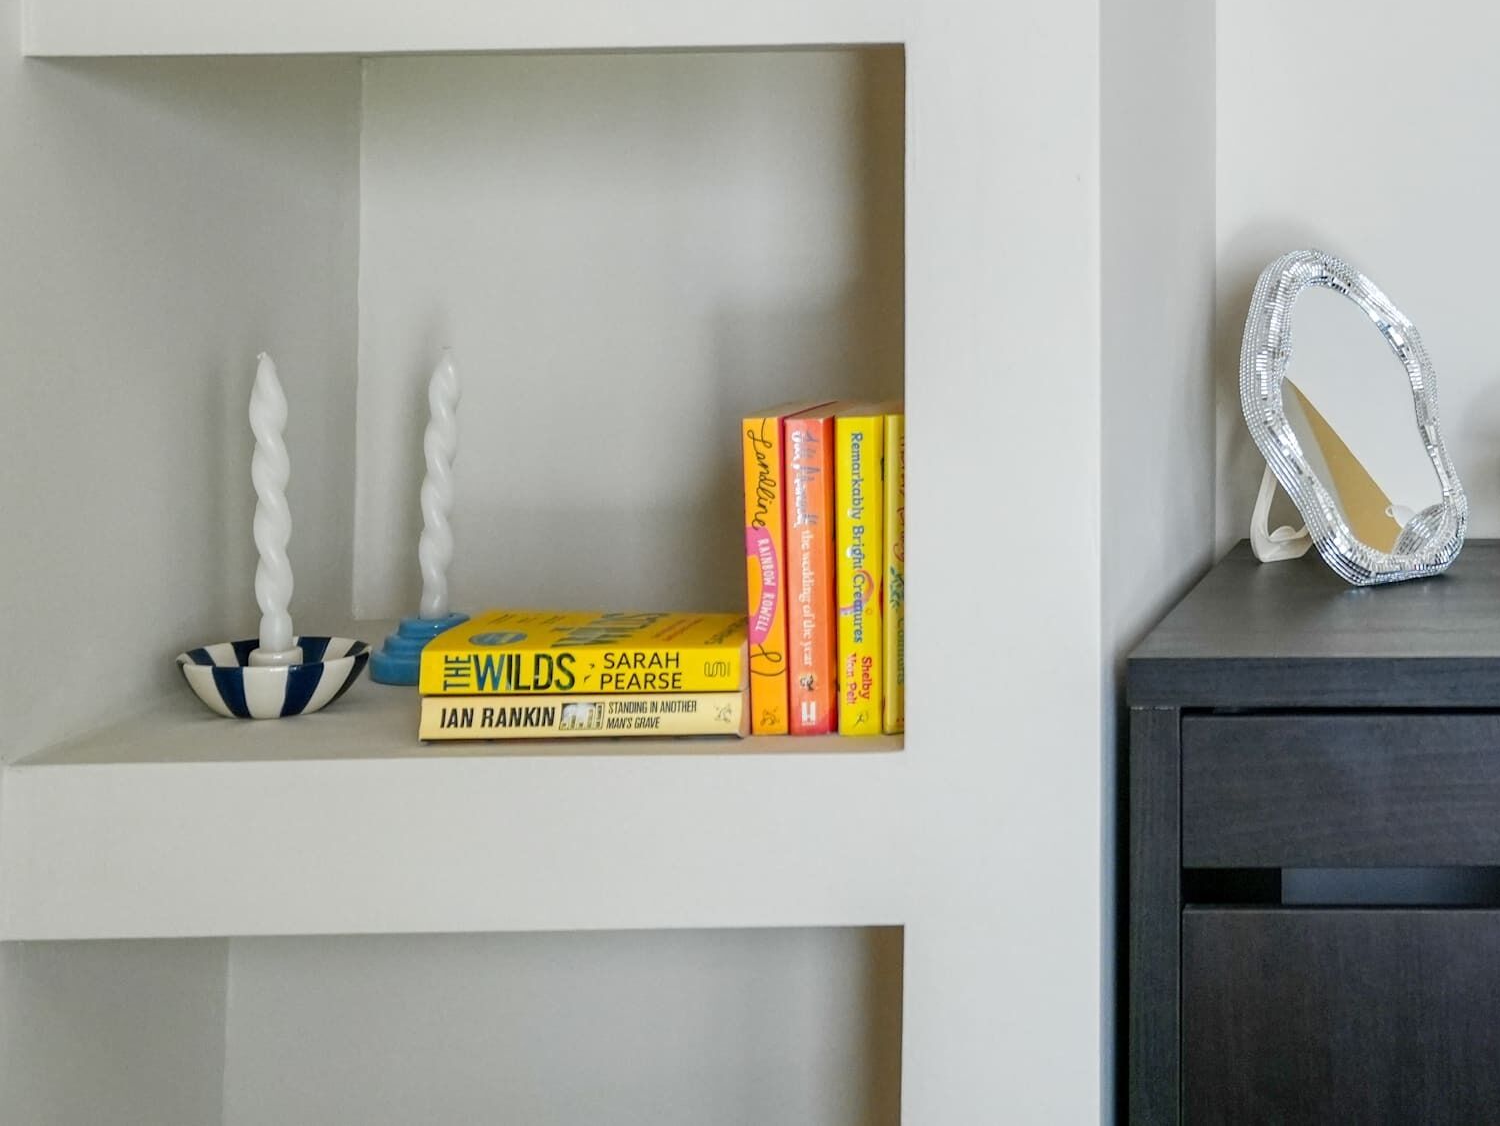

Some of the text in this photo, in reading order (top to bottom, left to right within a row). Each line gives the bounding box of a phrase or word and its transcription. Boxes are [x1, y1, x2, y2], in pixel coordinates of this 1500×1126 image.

[747, 427, 777, 531] Landline
[850, 432, 866, 643] Remarkably Bright Creatures
[755, 537, 776, 632] RAINBOW ROWELL
[799, 530, 816, 667] the wedding of the year
[443, 653, 576, 692] THE WILDS
[599, 671, 683, 691] PEARSE
[603, 651, 681, 670] SARAH
[846, 653, 857, 705] Van Pelt
[859, 656, 872, 700] Shelby
[440, 706, 556, 729] IAN RANKIN
[606, 716, 661, 730] MAN'S GRAVE
[608, 700, 697, 715] STANDING IN ANOTHER
